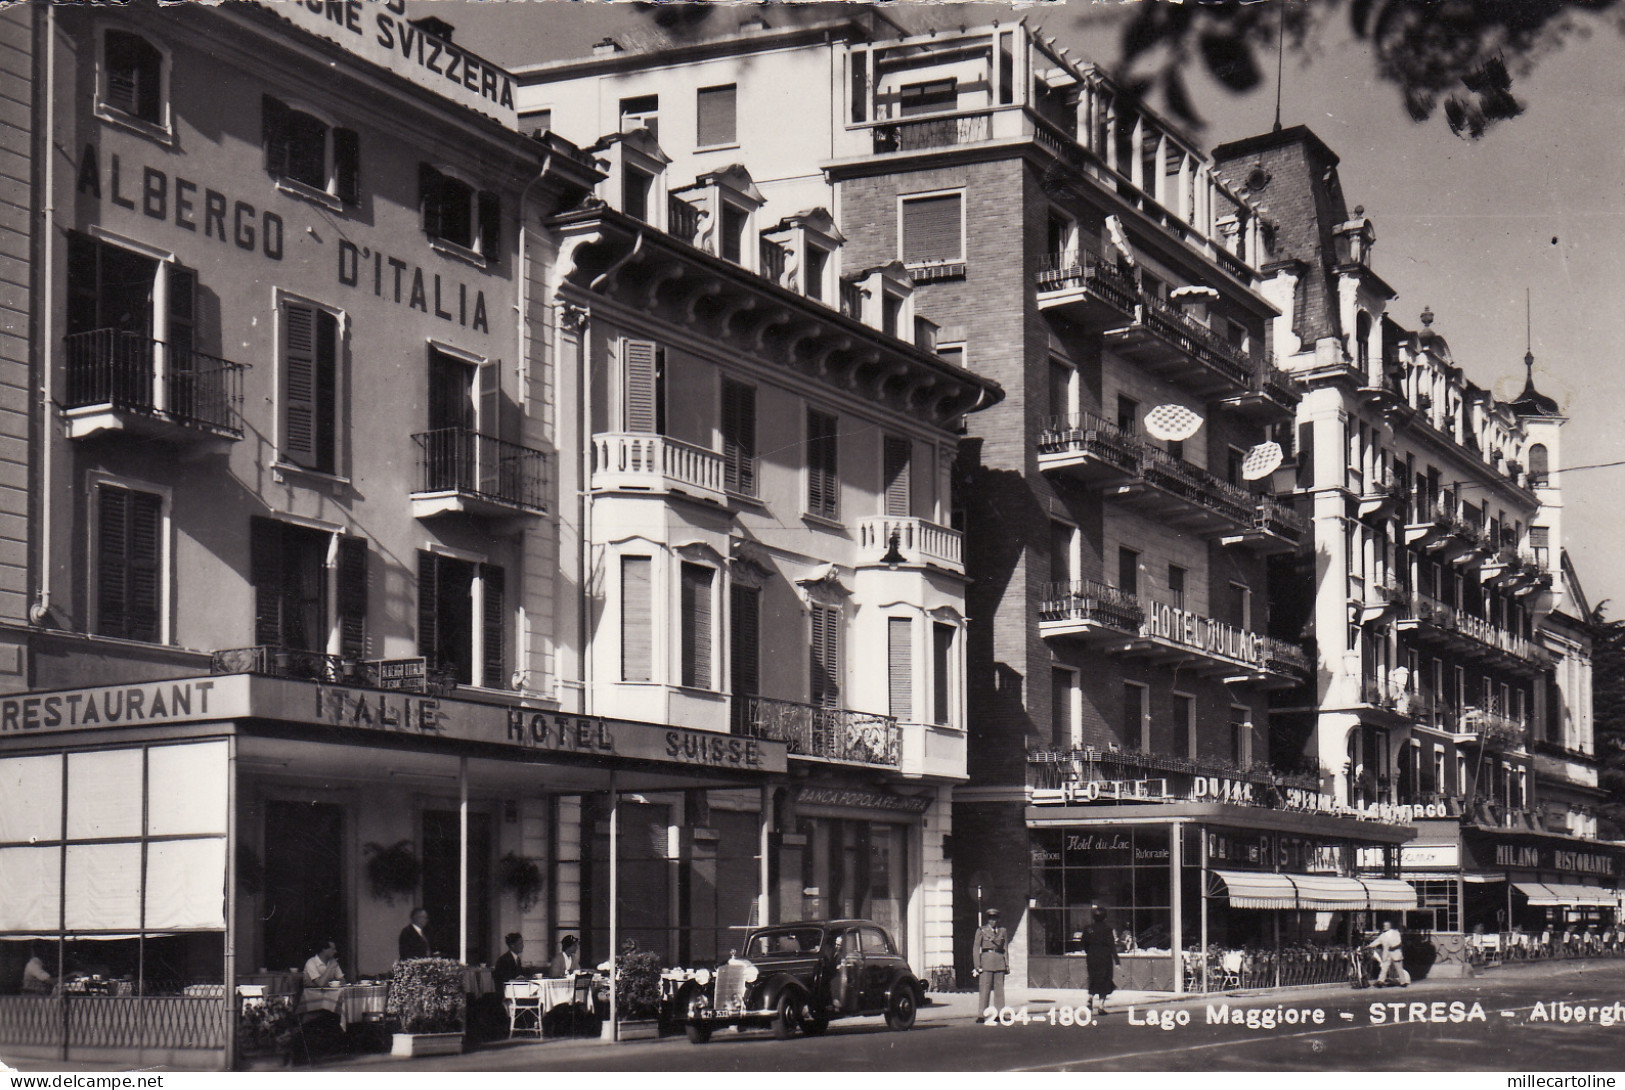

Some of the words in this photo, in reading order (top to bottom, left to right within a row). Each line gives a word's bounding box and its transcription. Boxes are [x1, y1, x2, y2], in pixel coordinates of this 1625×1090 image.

[376, 12, 515, 111] SVIZZERA
[76, 142, 284, 261] ALBERGO
[337, 237, 489, 334] D'ITALIA
[1150, 599, 1203, 649] HOTEL
[1229, 624, 1260, 663] LAC
[1456, 608, 1495, 646] ALBERGO
[1, 681, 214, 731] RESTAURANT
[316, 686, 437, 730] ITALIE
[507, 709, 612, 750] HOTEL
[665, 731, 759, 765] SUISSE
[798, 788, 838, 805] BANCA
[839, 792, 897, 809] POPOLARE
[1067, 835, 1093, 850] Hotel
[1096, 840, 1107, 850] du
[1109, 834, 1130, 850] Lac
[1496, 844, 1539, 868] MILANO
[1555, 850, 1613, 876] RISTORANTE
